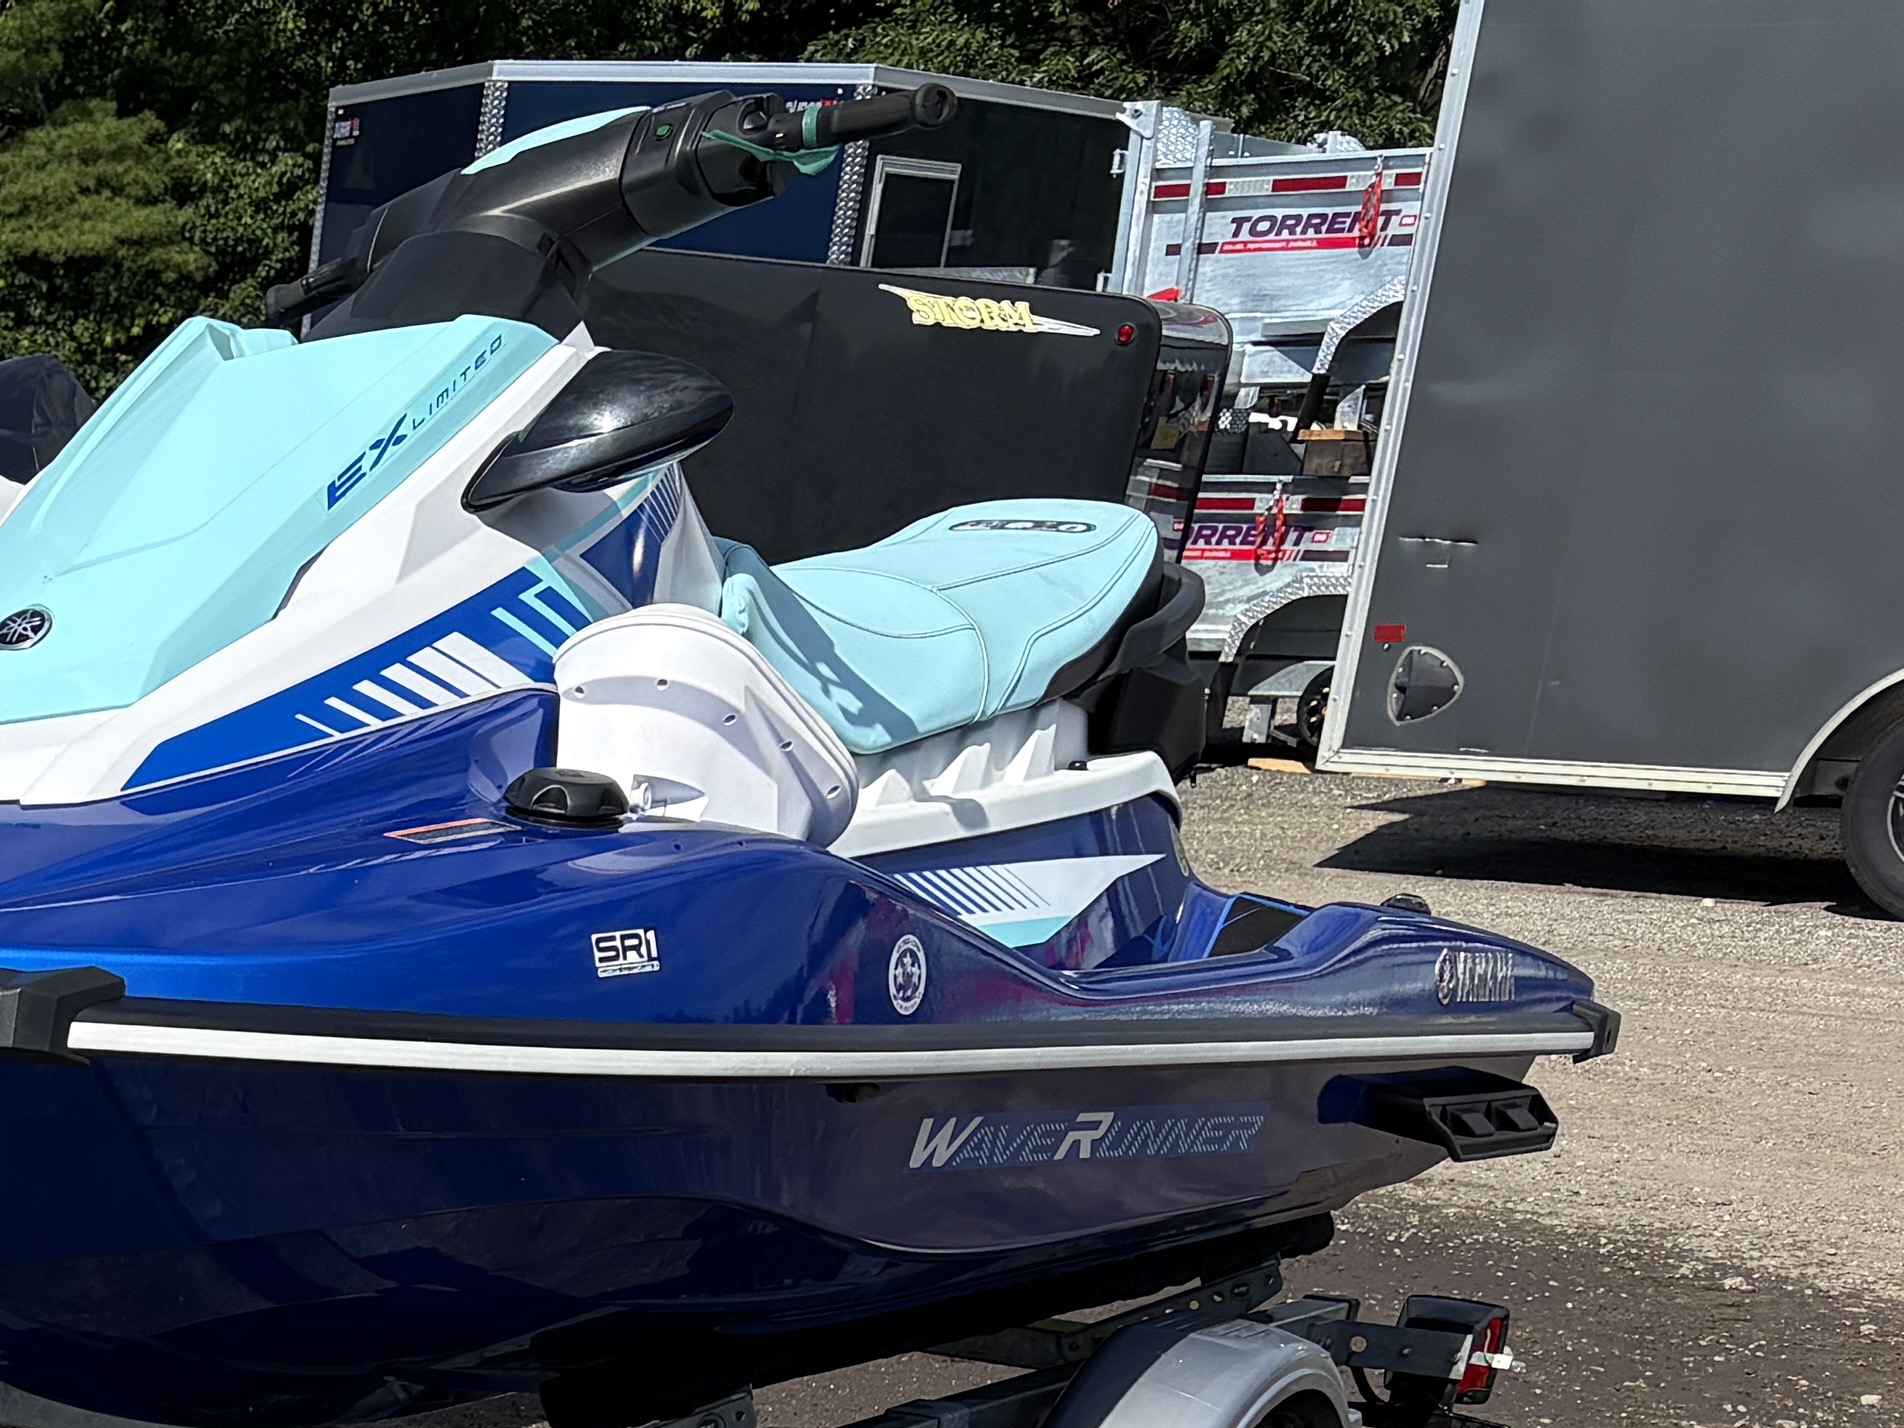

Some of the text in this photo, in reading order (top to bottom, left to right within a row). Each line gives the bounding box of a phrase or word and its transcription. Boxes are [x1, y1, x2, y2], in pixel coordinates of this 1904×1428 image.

[907, 295, 1038, 332] STORM
[327, 335, 502, 511] EX LIMITED
[595, 929, 658, 963] SR1
